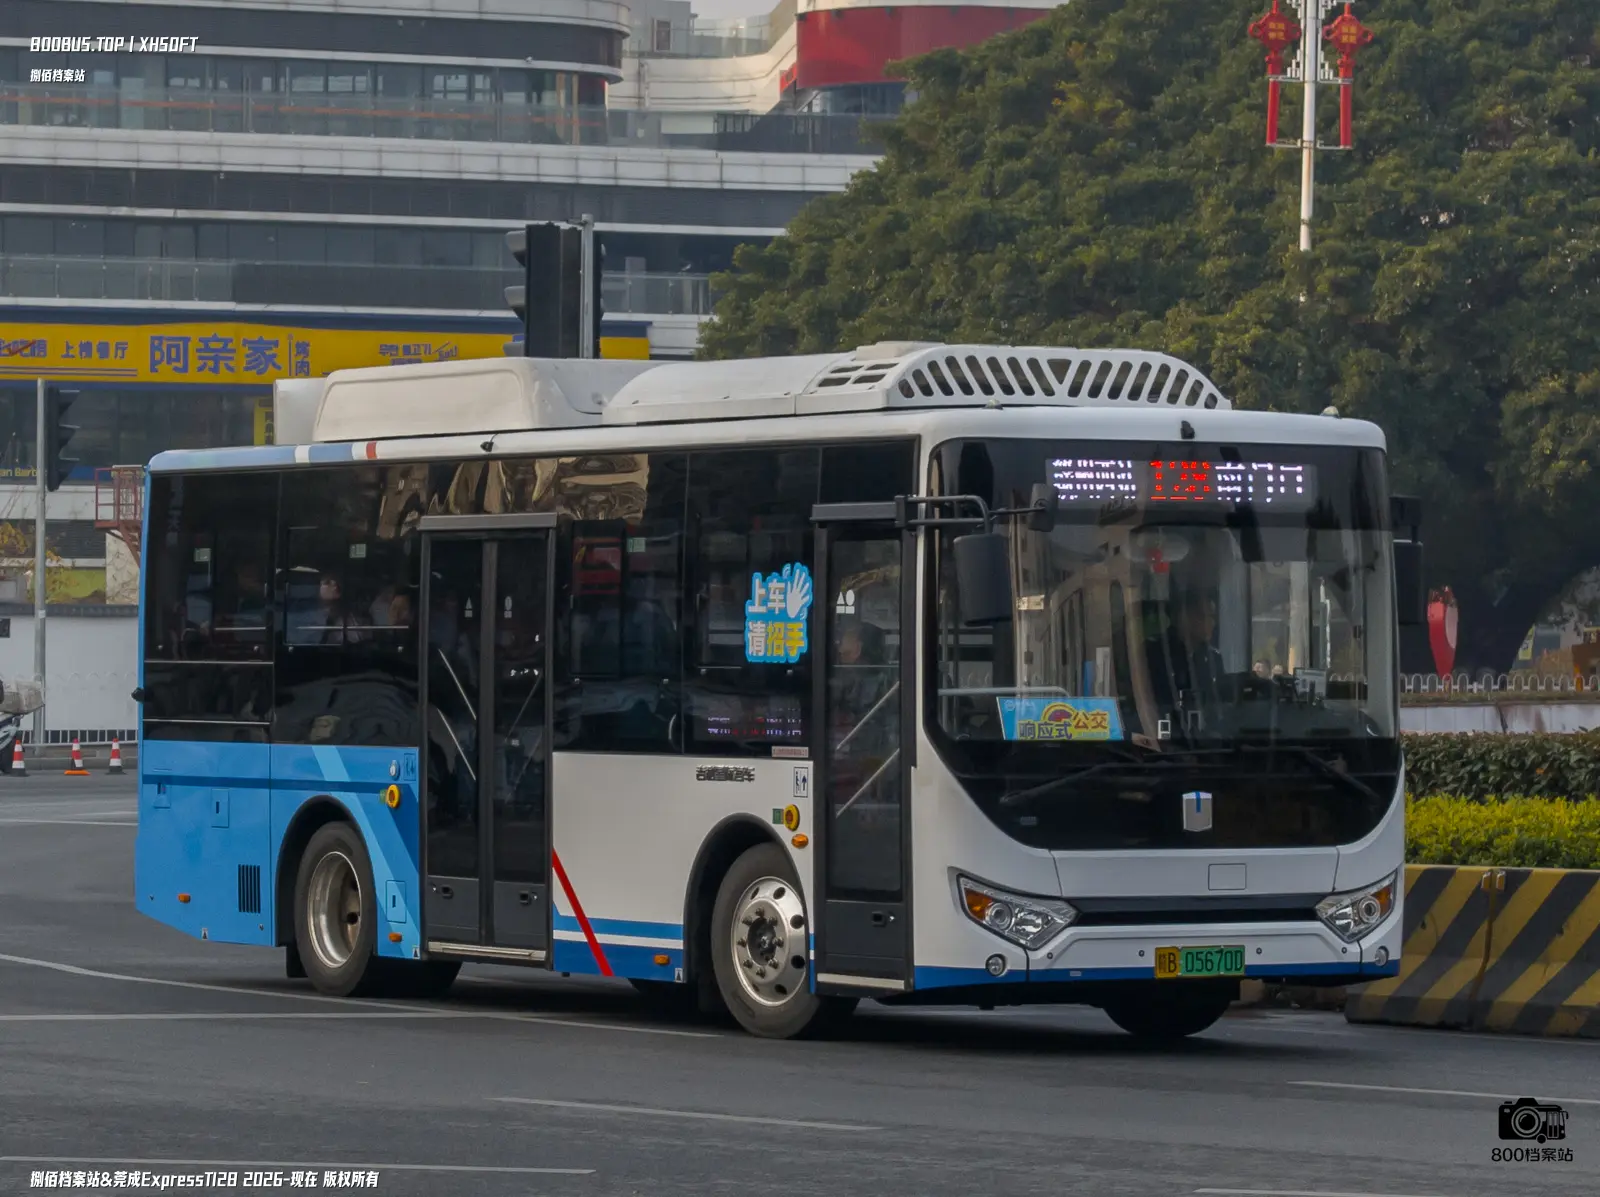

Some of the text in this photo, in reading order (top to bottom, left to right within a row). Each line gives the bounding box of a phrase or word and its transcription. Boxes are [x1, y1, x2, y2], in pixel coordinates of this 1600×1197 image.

[150, 333, 282, 375] 阿亲家
[748, 578, 786, 614] 上车
[748, 620, 805, 657] 请招手
[1020, 721, 1073, 740] 响应式
[1073, 711, 1108, 730] 公交
[1185, 950, 1243, 973] 05670D
